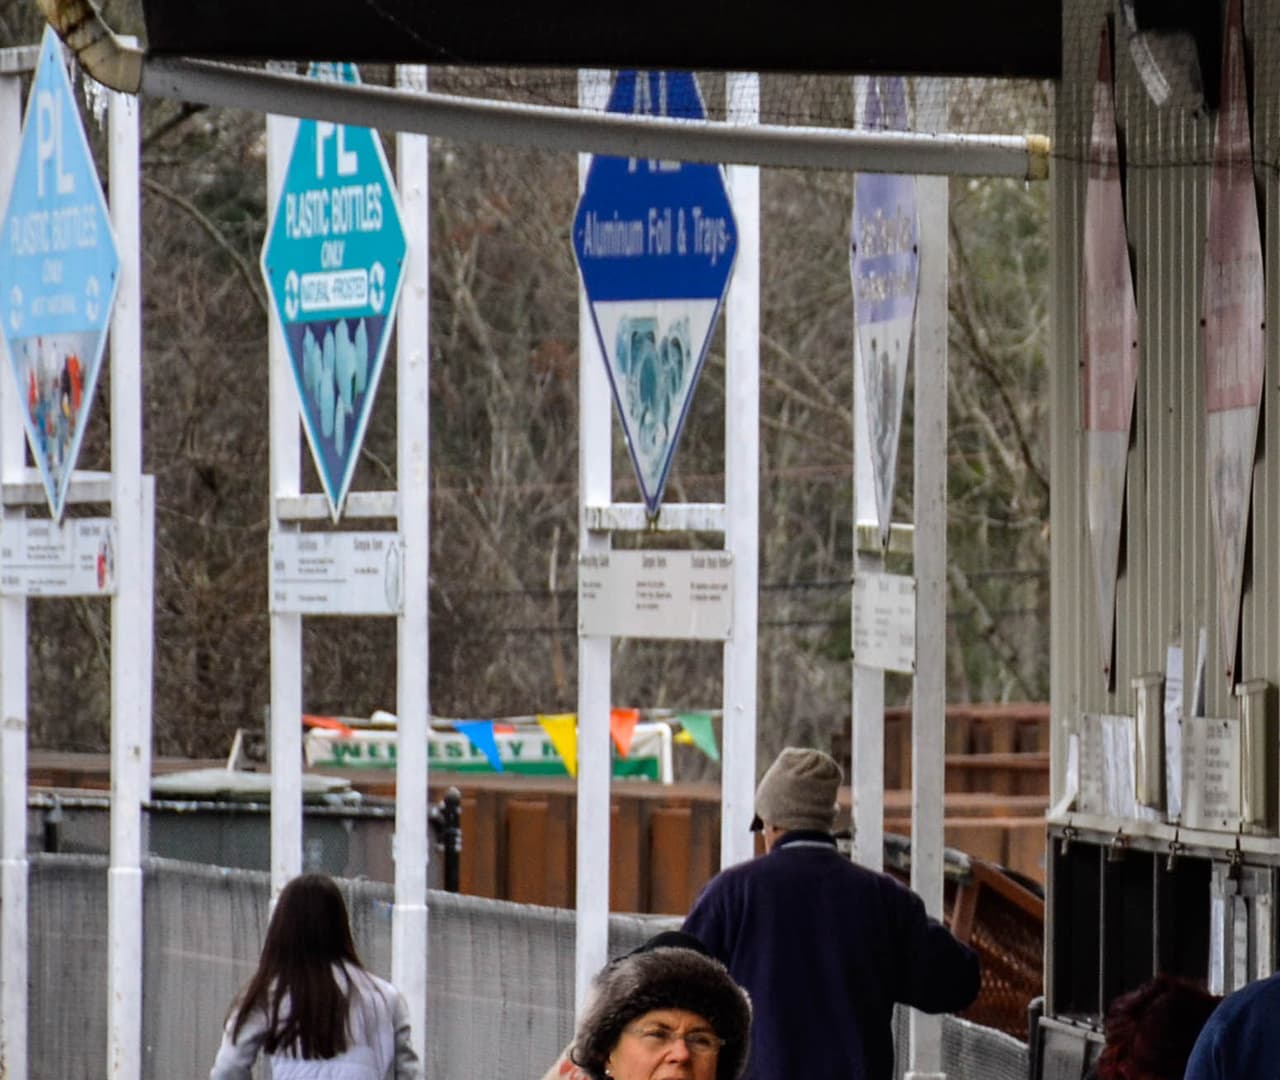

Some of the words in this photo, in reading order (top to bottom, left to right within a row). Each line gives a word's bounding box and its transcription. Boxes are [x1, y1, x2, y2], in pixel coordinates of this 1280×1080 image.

[37, 87, 75, 198] PL
[11, 211, 49, 256] PLASTIC
[52, 204, 97, 251] BOTTLES
[286, 187, 330, 239] PLASTIC
[332, 182, 383, 235] BOTTLES
[648, 206, 672, 256] Foil
[677, 206, 687, 256] &
[320, 240, 345, 269] ONLY
